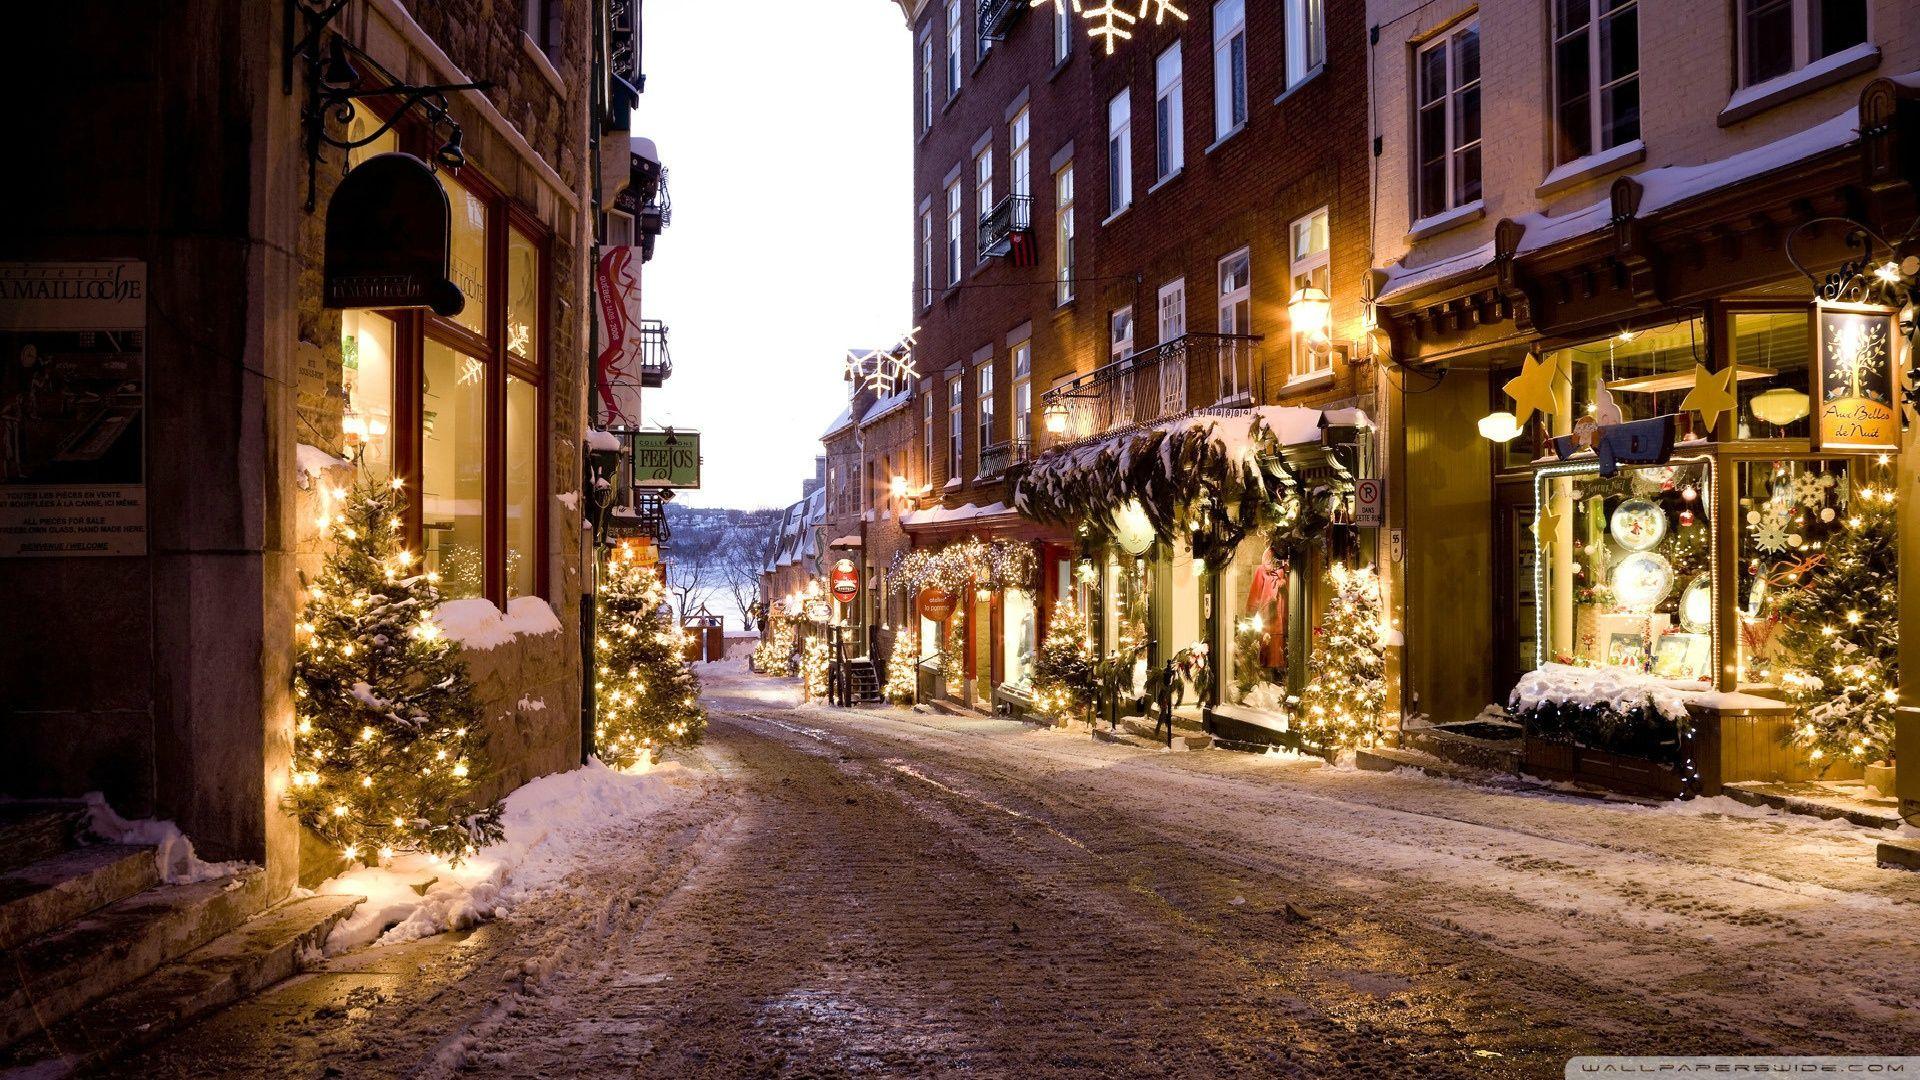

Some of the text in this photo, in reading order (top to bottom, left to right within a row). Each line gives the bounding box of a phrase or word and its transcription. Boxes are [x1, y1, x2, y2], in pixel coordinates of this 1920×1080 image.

[1823, 405, 1889, 420] Aux Belles
[1836, 422, 1879, 438] de Nuit
